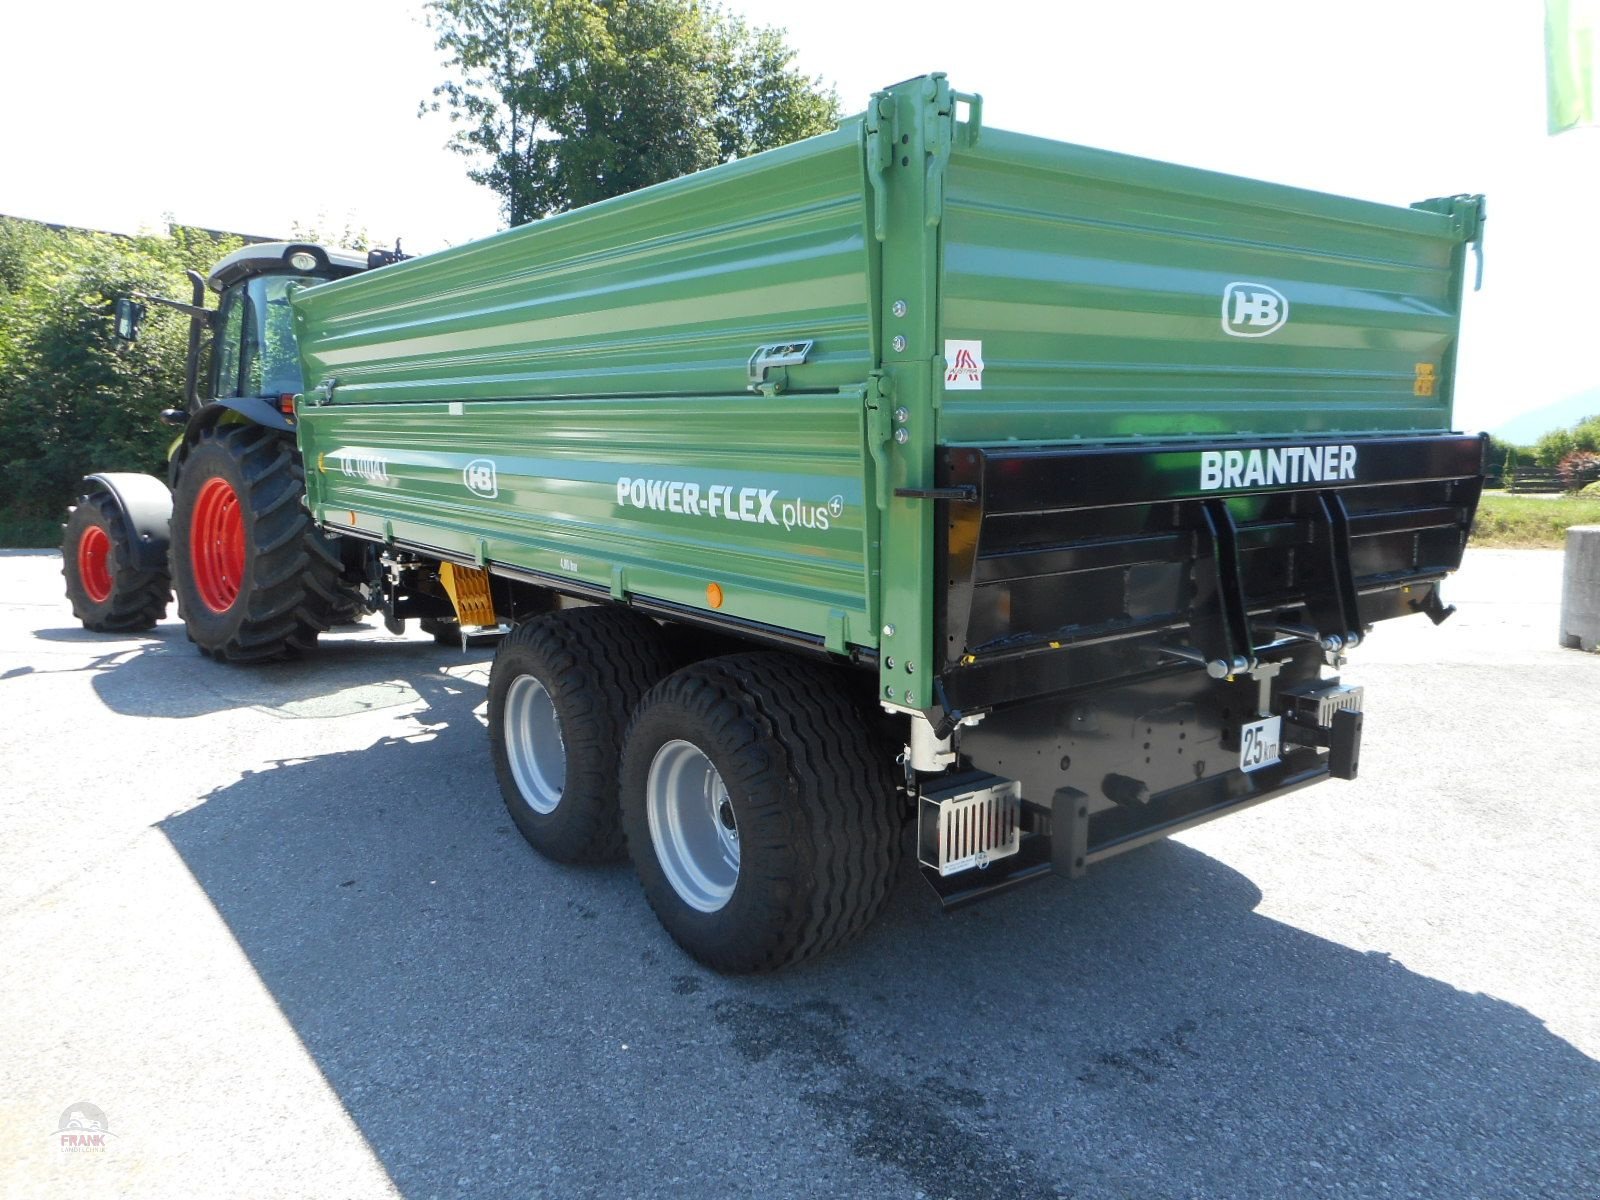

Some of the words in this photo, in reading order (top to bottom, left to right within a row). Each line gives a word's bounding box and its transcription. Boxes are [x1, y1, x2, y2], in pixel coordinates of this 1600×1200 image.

[1200, 445, 1357, 490] BRANTNER
[617, 477, 779, 525] POWER-FLEX
[1243, 726, 1264, 767] 25
[1264, 741, 1277, 760] km
